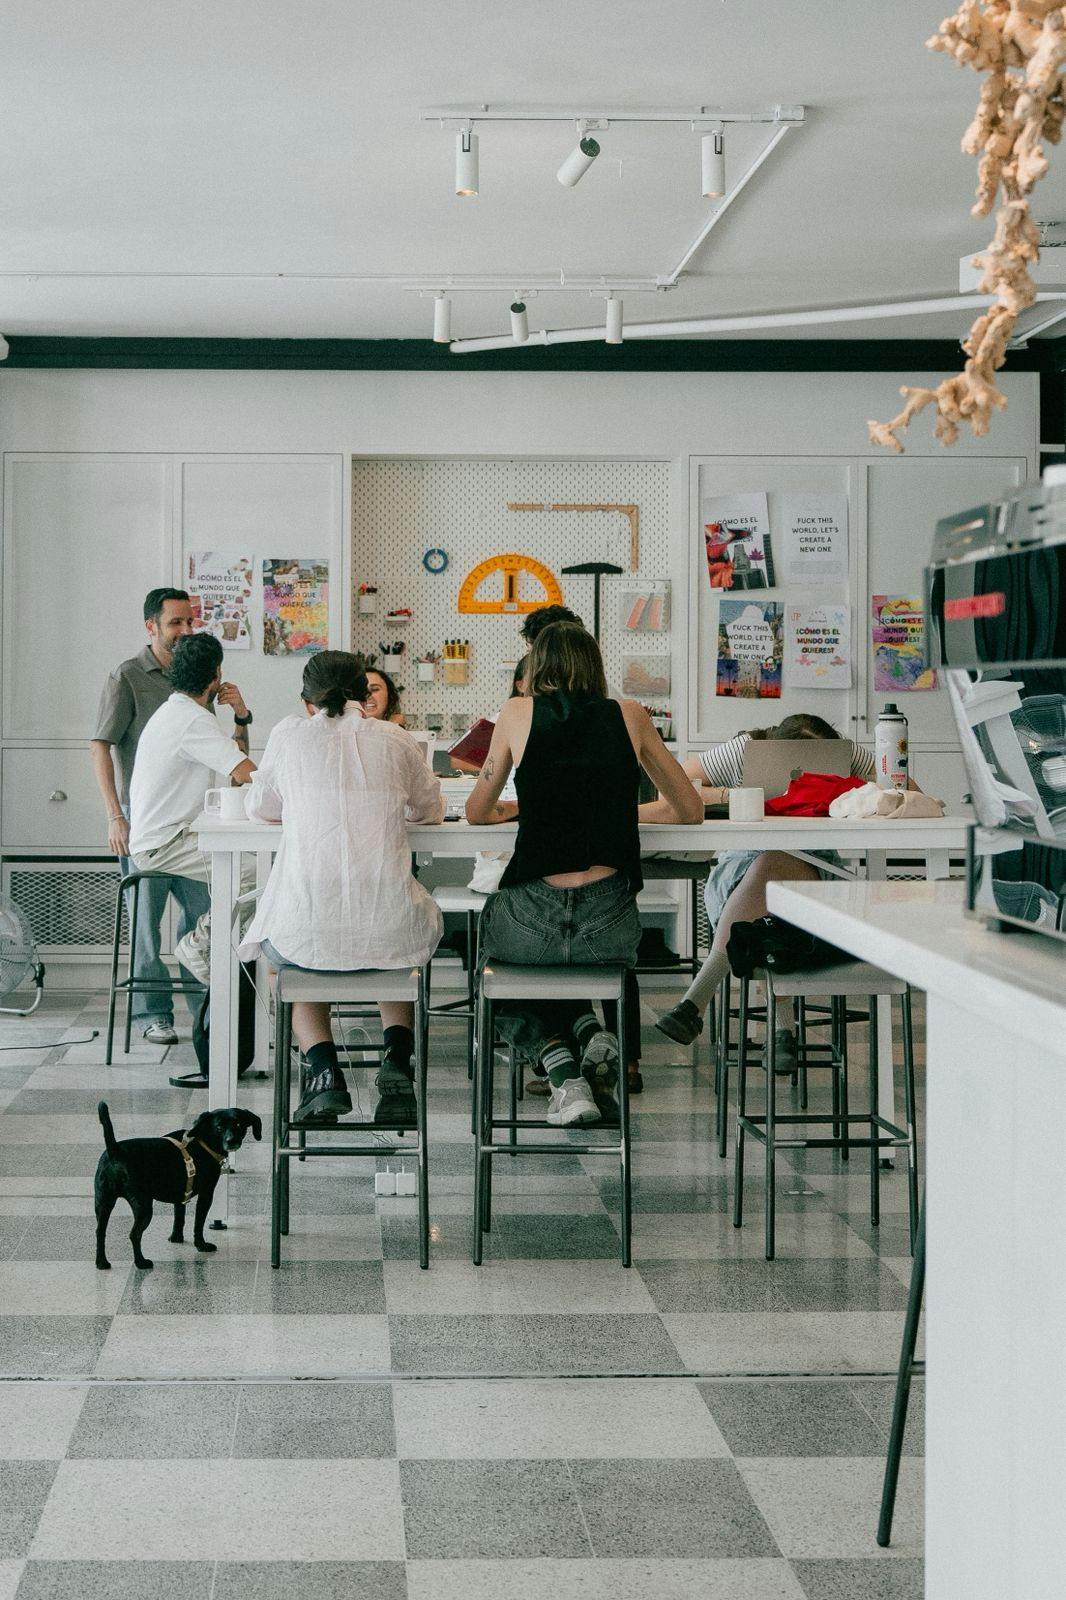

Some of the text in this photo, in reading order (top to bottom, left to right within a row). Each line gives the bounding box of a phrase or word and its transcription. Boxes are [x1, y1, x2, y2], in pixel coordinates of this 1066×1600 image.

[821, 628, 831, 636] ES
[831, 628, 841, 636] EL
[883, 626, 908, 634] MUNDO
[797, 637, 840, 645] MUNDO QUE
